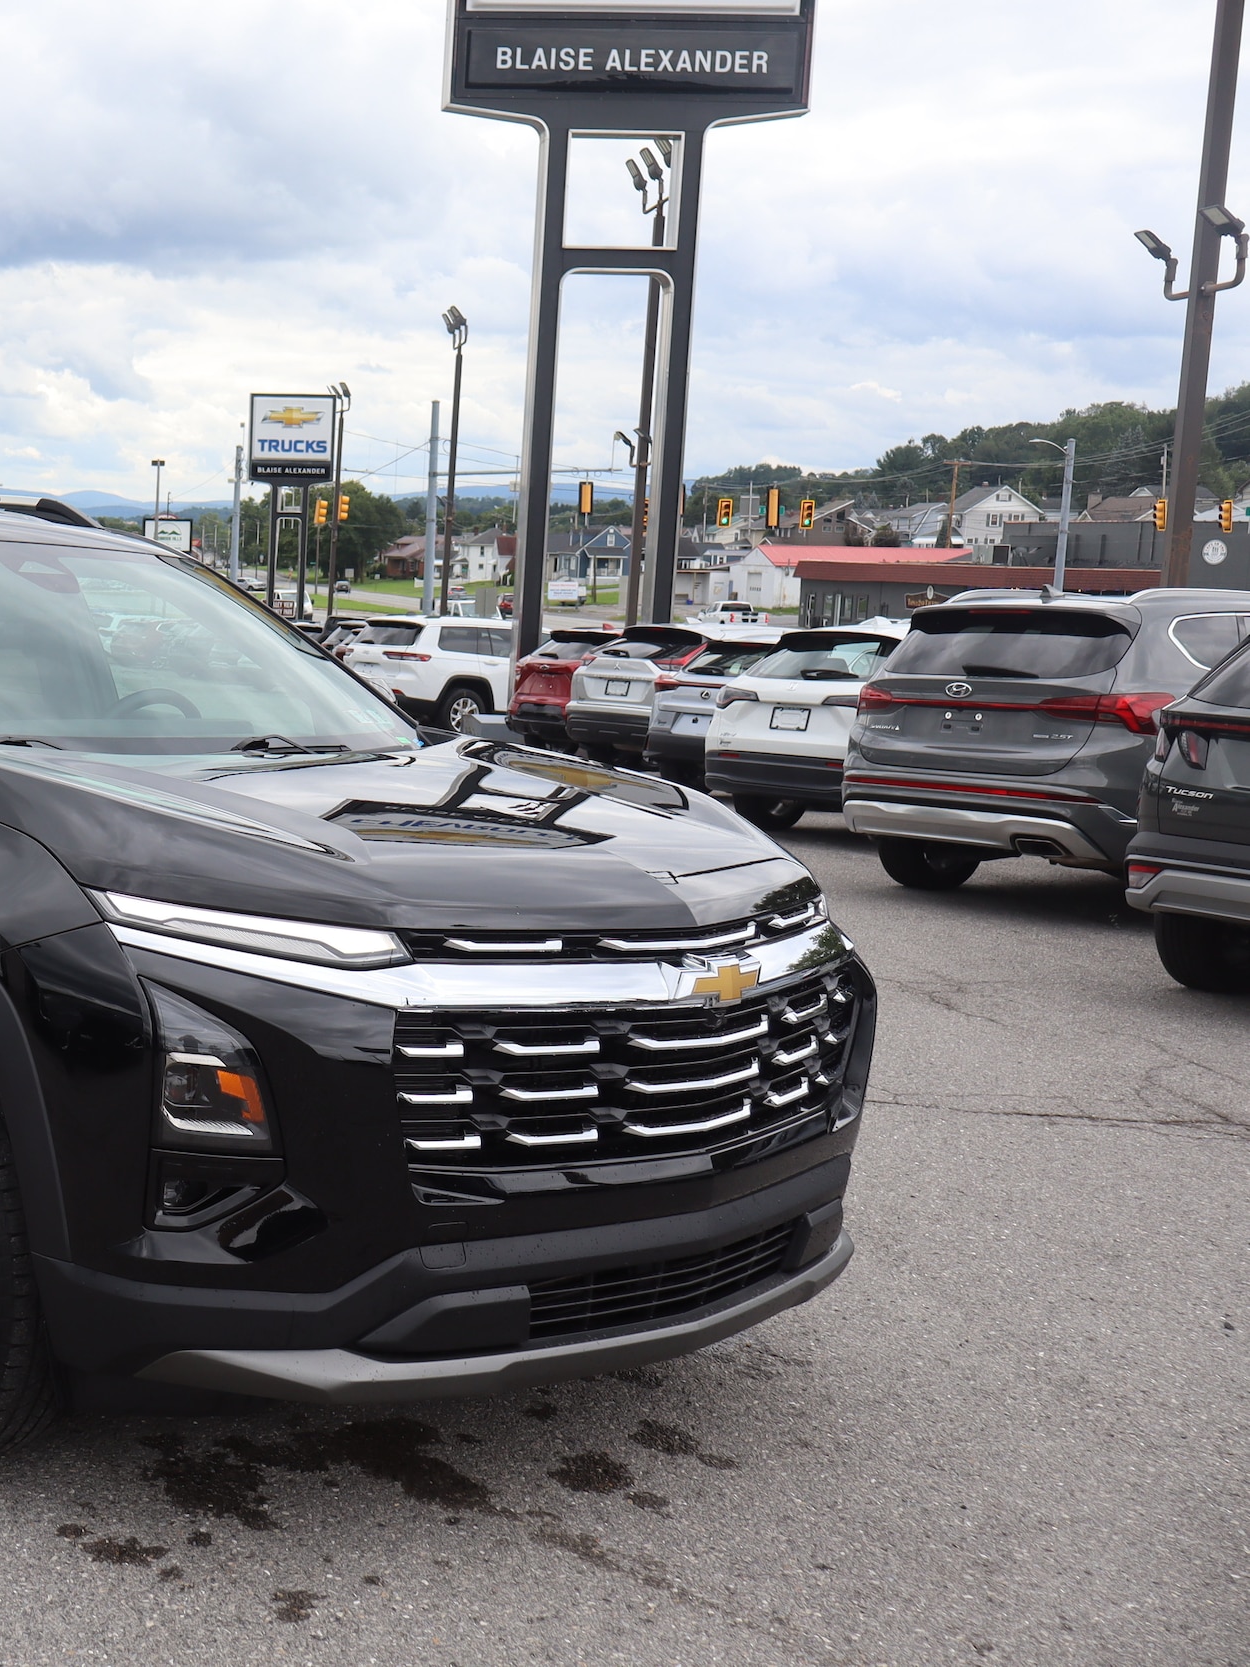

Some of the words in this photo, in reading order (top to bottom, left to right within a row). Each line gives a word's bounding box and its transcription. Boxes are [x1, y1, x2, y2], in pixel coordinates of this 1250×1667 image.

[496, 46, 594, 71] BLAISE
[605, 49, 769, 74] ALEXANDER
[257, 439, 327, 453] TRUCKS
[257, 466, 283, 474] BLAISE
[284, 467, 326, 475] ALEXANDER
